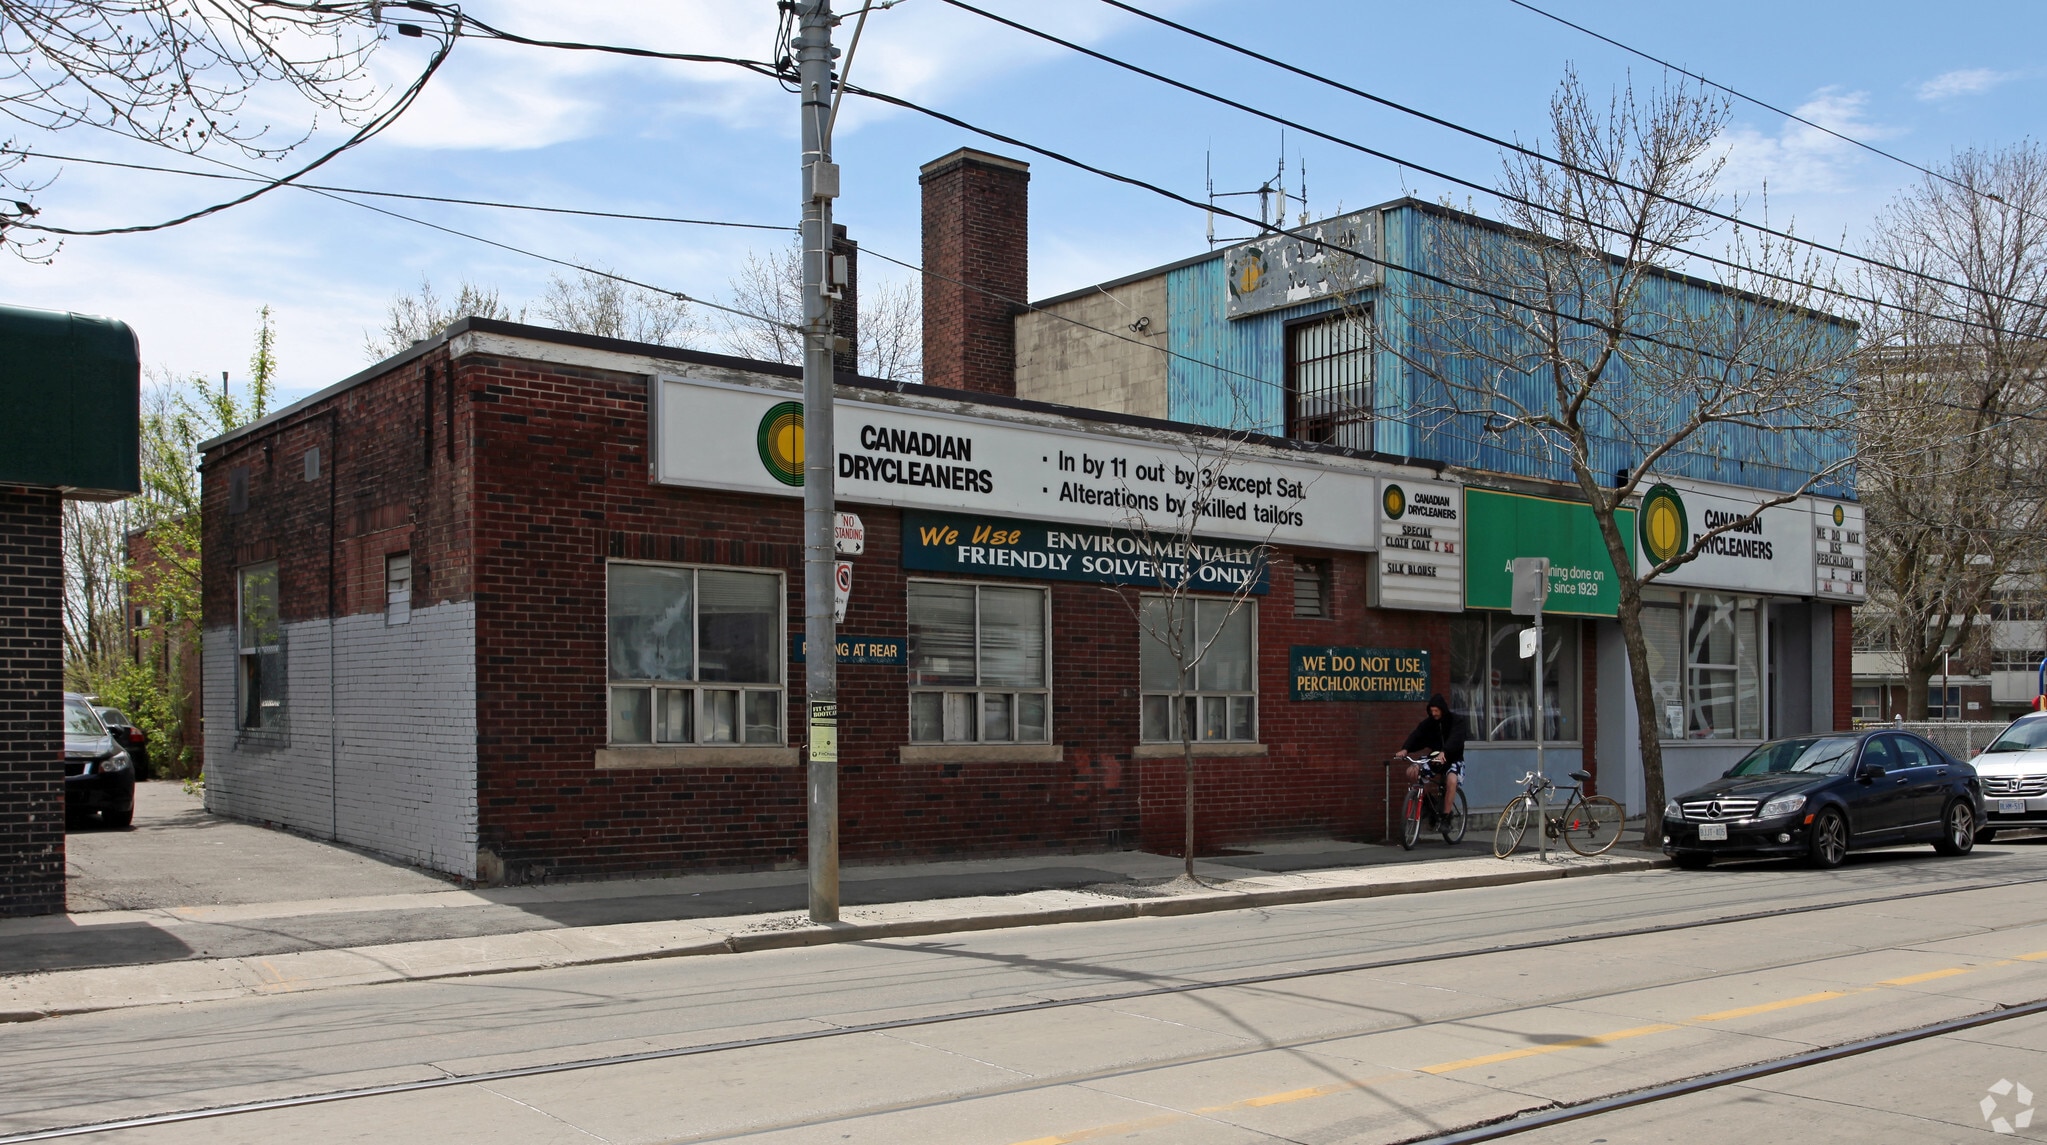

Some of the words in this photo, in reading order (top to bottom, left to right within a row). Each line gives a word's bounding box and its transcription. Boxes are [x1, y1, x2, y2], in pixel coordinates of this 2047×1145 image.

[860, 424, 971, 462] CANADIAN
[839, 454, 993, 493] DRYCLEANERS
[1059, 451, 1075, 471] In
[1083, 453, 1105, 478] by
[1110, 457, 1127, 477] 11
[1136, 464, 1165, 482] out
[1175, 465, 1195, 489] by
[1202, 469, 1213, 488] 3
[1218, 474, 1272, 499] except
[1059, 481, 1159, 512] Alterations
[1166, 493, 1187, 517] by
[1192, 497, 1247, 520] skilled
[1253, 503, 1303, 526] tailors
[1414, 492, 1450, 507] CANADIAN
[1408, 504, 1457, 520] DRYCLEANERS
[843, 515, 854, 527] NO
[1705, 509, 1762, 535] CANADIAN
[835, 527, 863, 541] STANDING
[1402, 525, 1432, 538] SPECIAL
[919, 526, 959, 546] We
[971, 525, 1021, 545] Use
[1047, 531, 1252, 565] ENVIRONMENTALLY
[1385, 536, 1409, 549] CLOTH
[1411, 538, 1430, 551] COAT
[1694, 533, 1773, 560] DRYCLEANERS
[958, 546, 1072, 571] FRIENDLY
[1082, 556, 1191, 581] SOLVENTS
[1199, 565, 1254, 585] ONLY
[1387, 563, 1404, 574] SILK
[1408, 564, 1437, 577] BLOUSE
[1569, 566, 1595, 580] done
[1593, 570, 1604, 581] on
[1554, 582, 1576, 595] since
[1577, 582, 1598, 596] 1929
[853, 643, 866, 657] AT
[869, 644, 898, 657] REAR
[1302, 655, 1326, 671] WE
[1331, 656, 1355, 672] DO
[1361, 656, 1390, 672] NOT
[1395, 657, 1420, 673] USE
[1297, 675, 1425, 692] PERCHLOROETHYLENE
